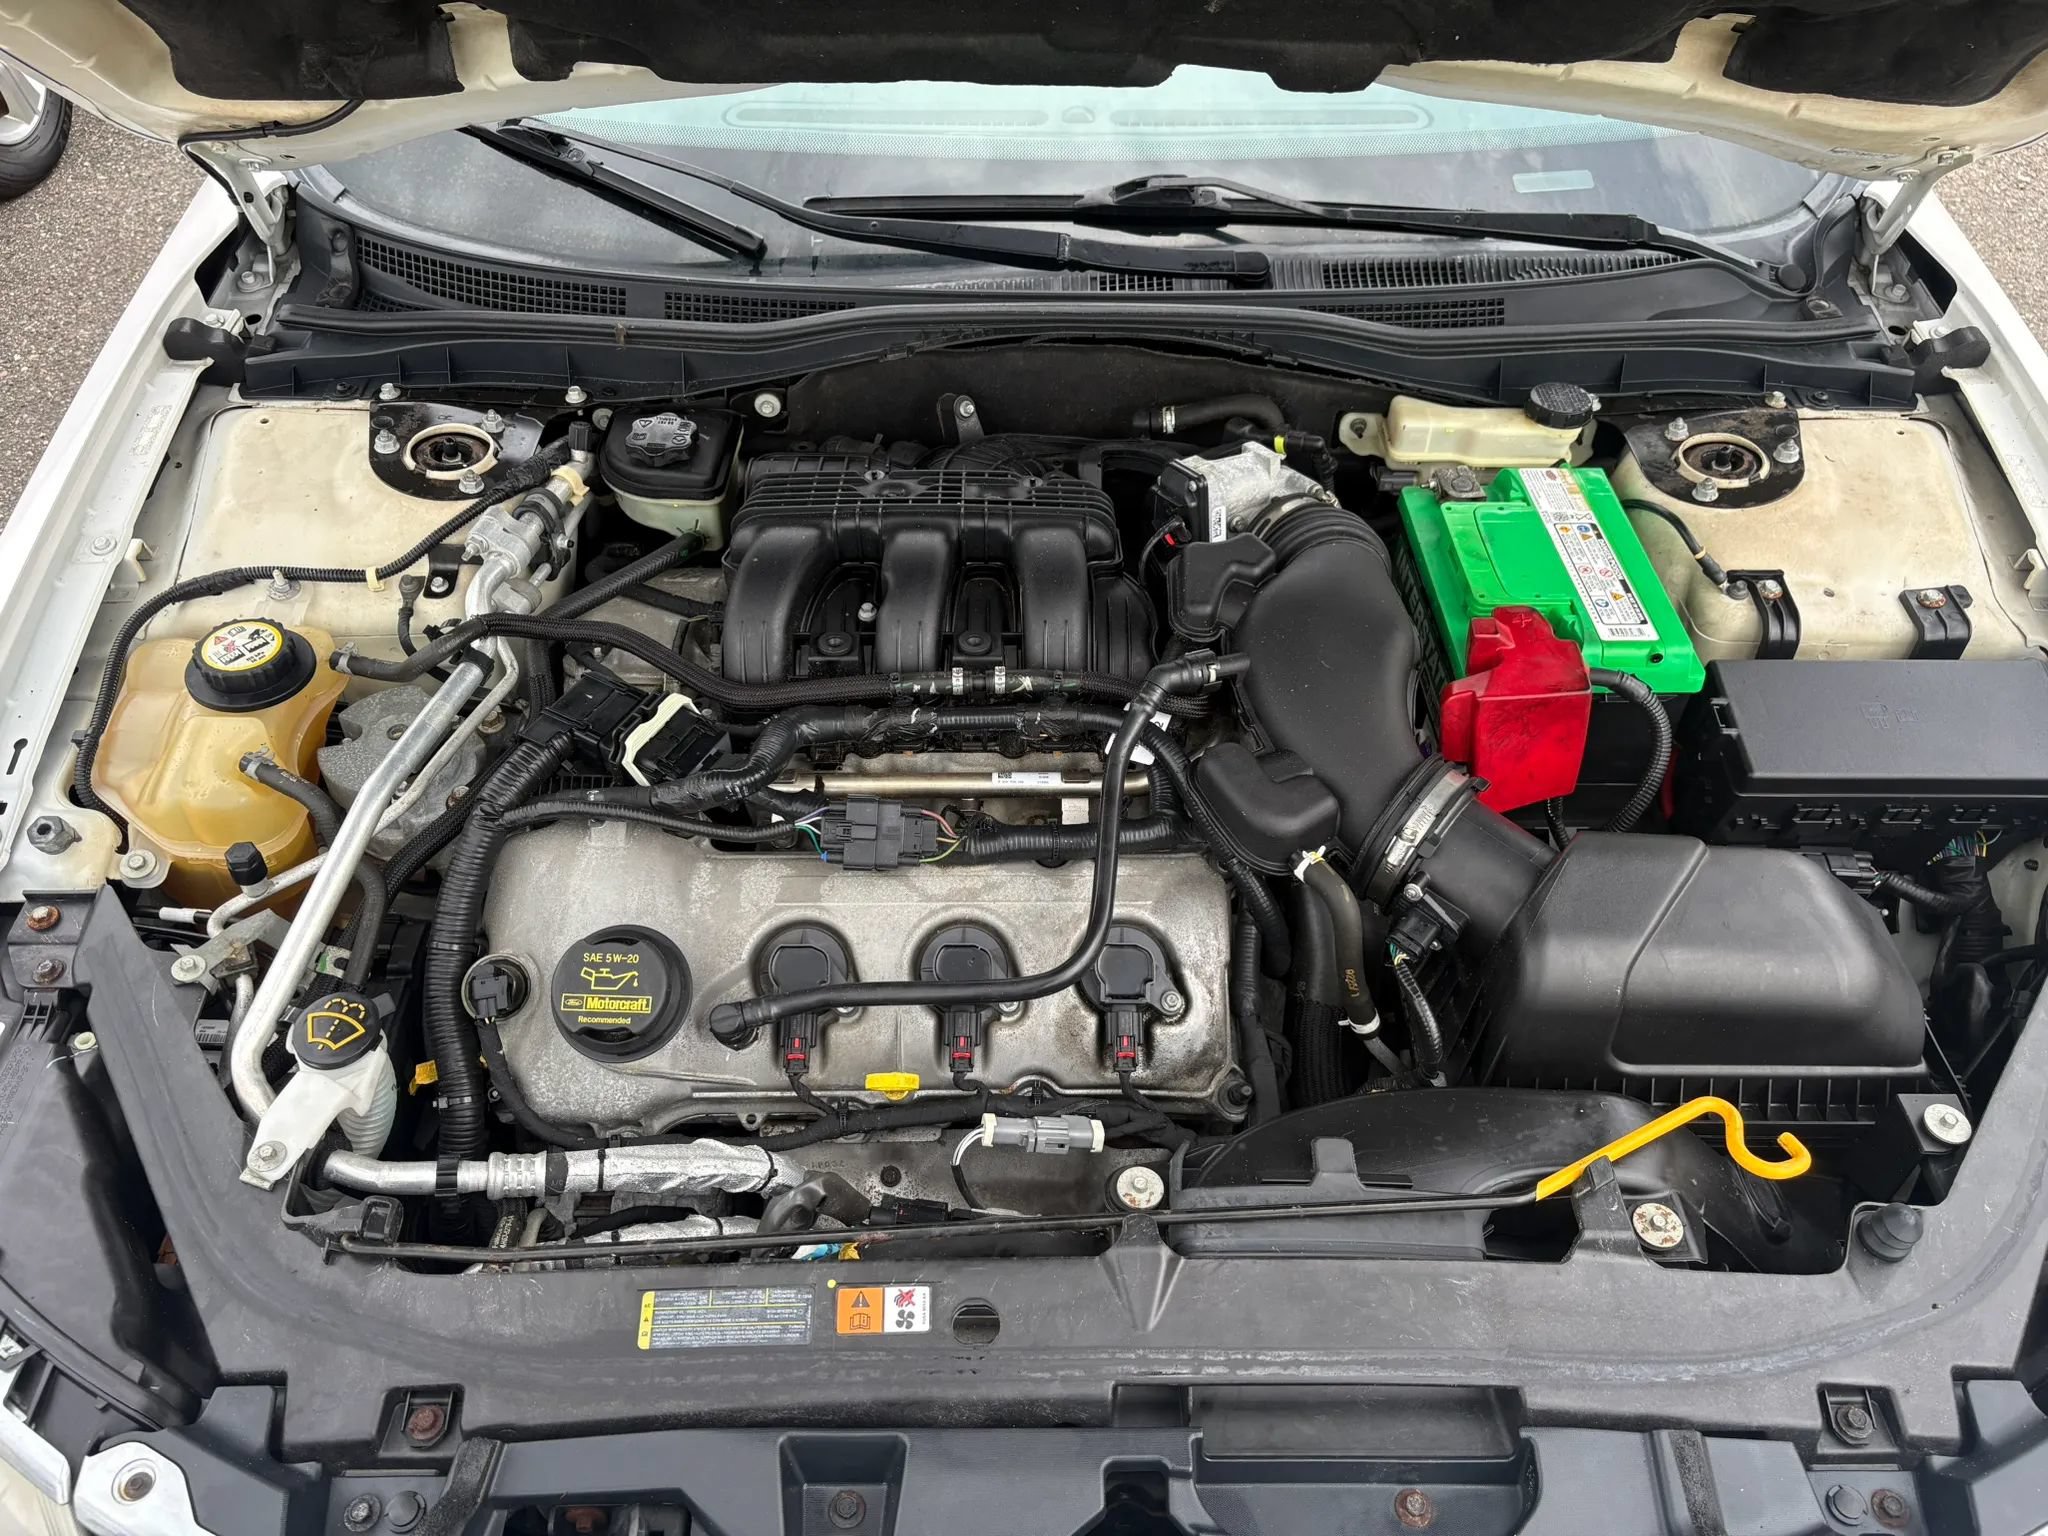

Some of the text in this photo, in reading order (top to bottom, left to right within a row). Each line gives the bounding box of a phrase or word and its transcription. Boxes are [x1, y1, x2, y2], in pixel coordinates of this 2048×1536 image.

[1396, 546, 1448, 689] INTERSTAT
[583, 952, 639, 963] SAE 5W-20
[586, 996, 650, 1011] Motorcraft
[577, 1015, 631, 1024] Recommended
